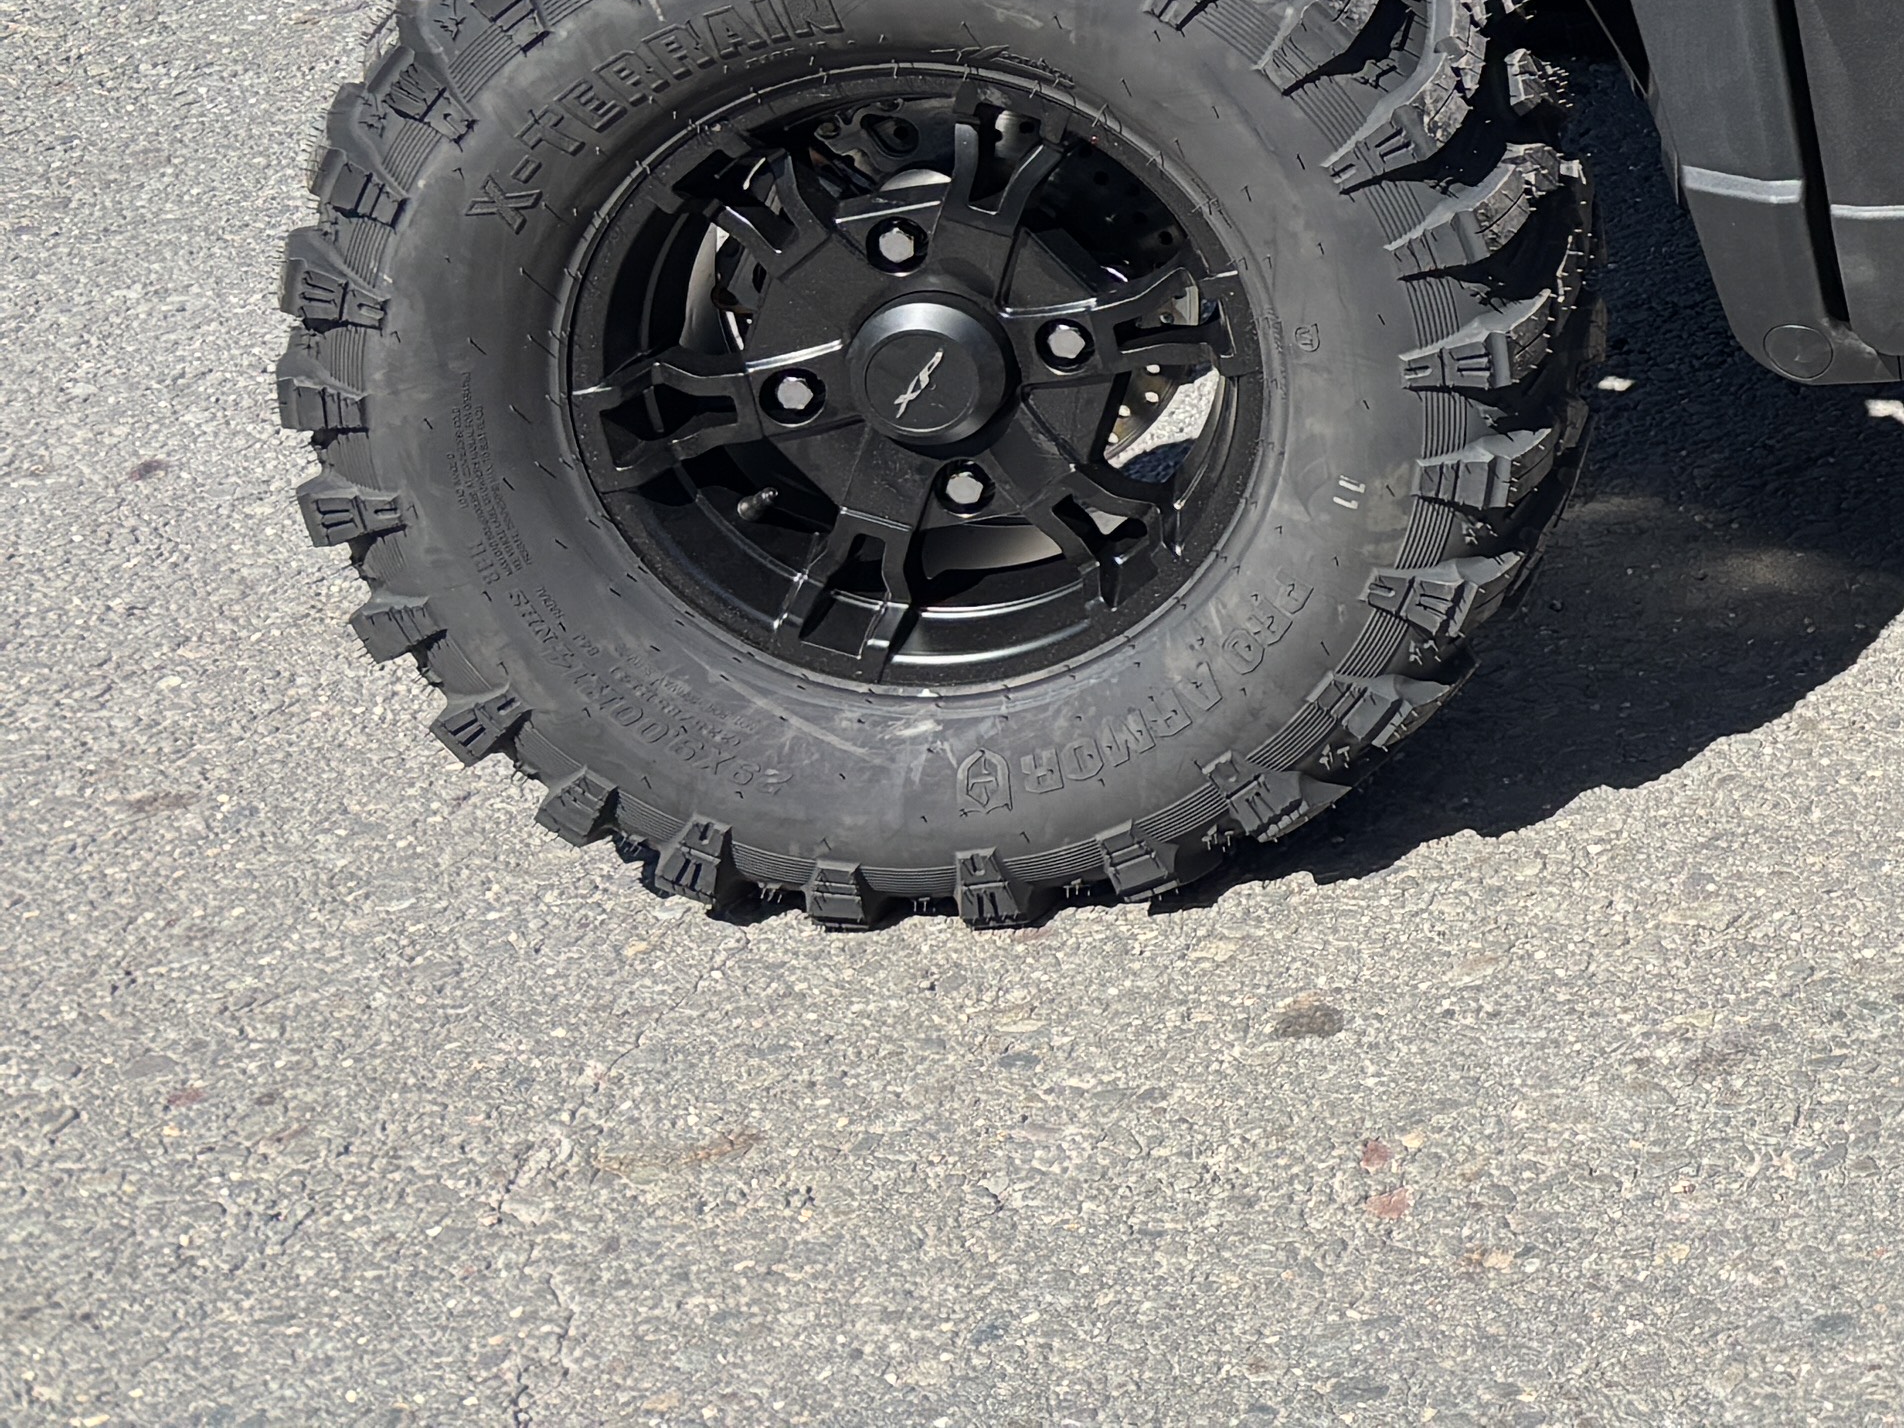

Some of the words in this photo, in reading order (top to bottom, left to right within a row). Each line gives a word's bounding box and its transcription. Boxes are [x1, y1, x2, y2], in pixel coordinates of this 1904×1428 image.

[893, 348, 944, 419] XP
[1222, 571, 1314, 676] PRO
[1020, 660, 1223, 795] ARMOR
